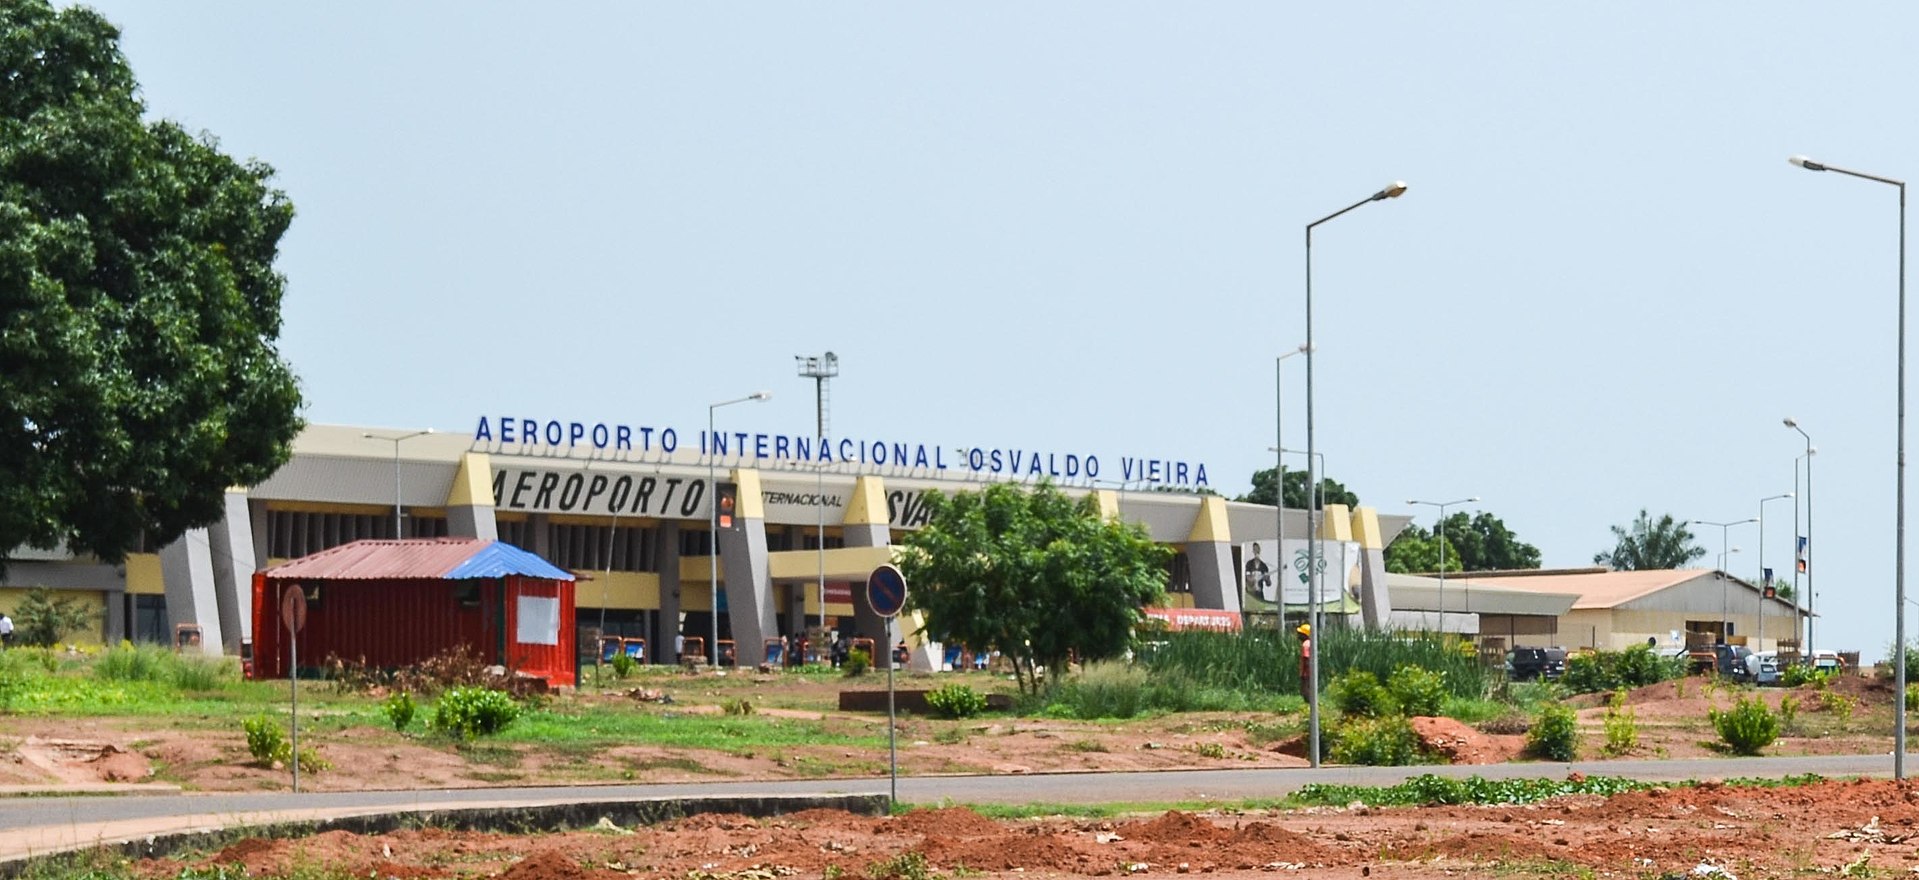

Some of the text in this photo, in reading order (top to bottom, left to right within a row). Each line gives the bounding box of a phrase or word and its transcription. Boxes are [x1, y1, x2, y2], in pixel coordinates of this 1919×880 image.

[476, 416, 1208, 486] AEROPORTO INTERNACIONAL OSVALDO VIEIRA
[492, 469, 706, 517] AEROPORTO
